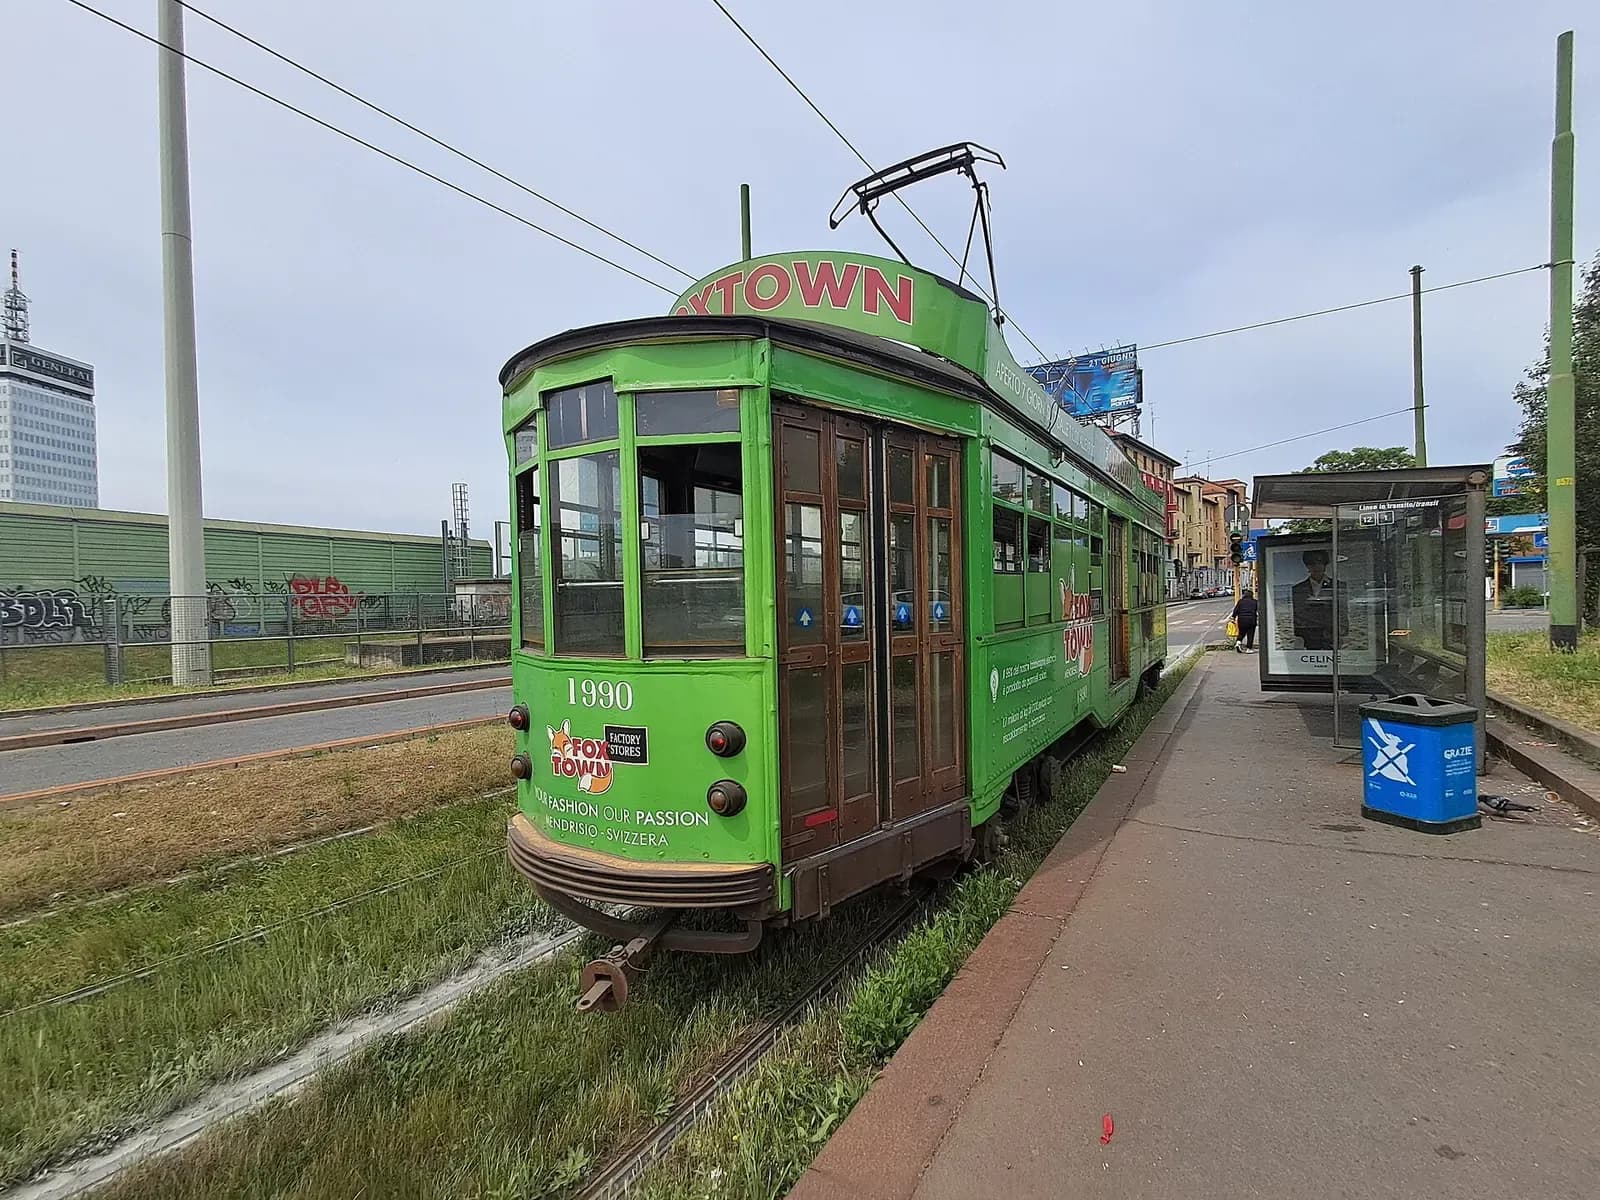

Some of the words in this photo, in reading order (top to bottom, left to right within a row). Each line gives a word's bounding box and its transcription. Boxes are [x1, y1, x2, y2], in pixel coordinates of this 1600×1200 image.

[676, 260, 914, 326] XTOWN
[1101, 351, 1135, 365] GIUGNO
[995, 361, 1020, 395] APERTO
[1300, 655, 1341, 664] CELINE
[568, 677, 633, 711] 1990
[572, 738, 610, 760] FOX
[609, 732, 641, 746] FACTORY
[609, 744, 641, 757] STORES
[1443, 746, 1473, 759] GRAZIE
[551, 756, 611, 777] TOWN
[549, 796, 599, 819] FASHION
[603, 806, 631, 823] OUR
[636, 811, 709, 827] PASSION
[606, 828, 669, 847] SVIZZERA
